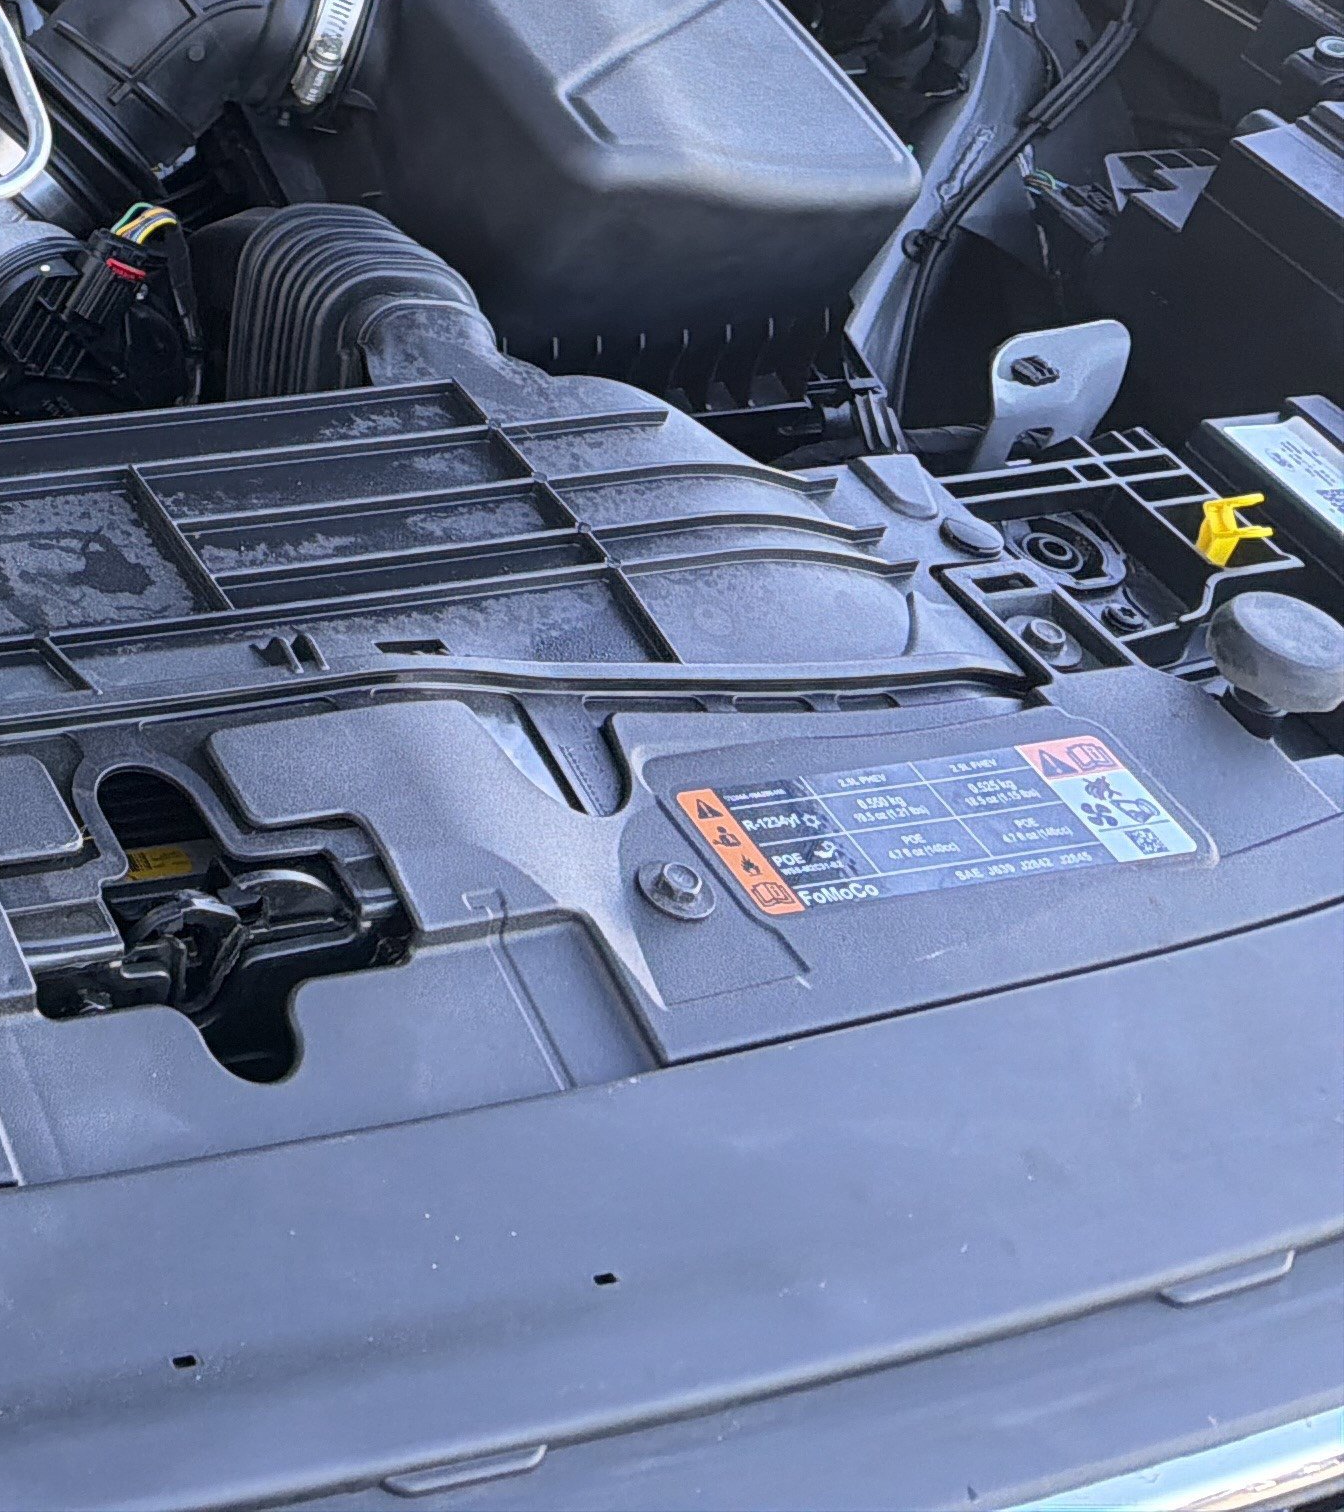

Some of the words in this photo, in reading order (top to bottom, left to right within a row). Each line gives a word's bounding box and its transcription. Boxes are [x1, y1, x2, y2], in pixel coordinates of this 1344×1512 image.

[967, 779, 1000, 794] 0.525
[996, 778, 1018, 790] kg
[886, 795, 907, 808] kg
[740, 813, 801, 832] R-1234yf
[771, 852, 806, 867] POE
[954, 868, 984, 880] SAE
[797, 882, 879, 907] FoMoCo
